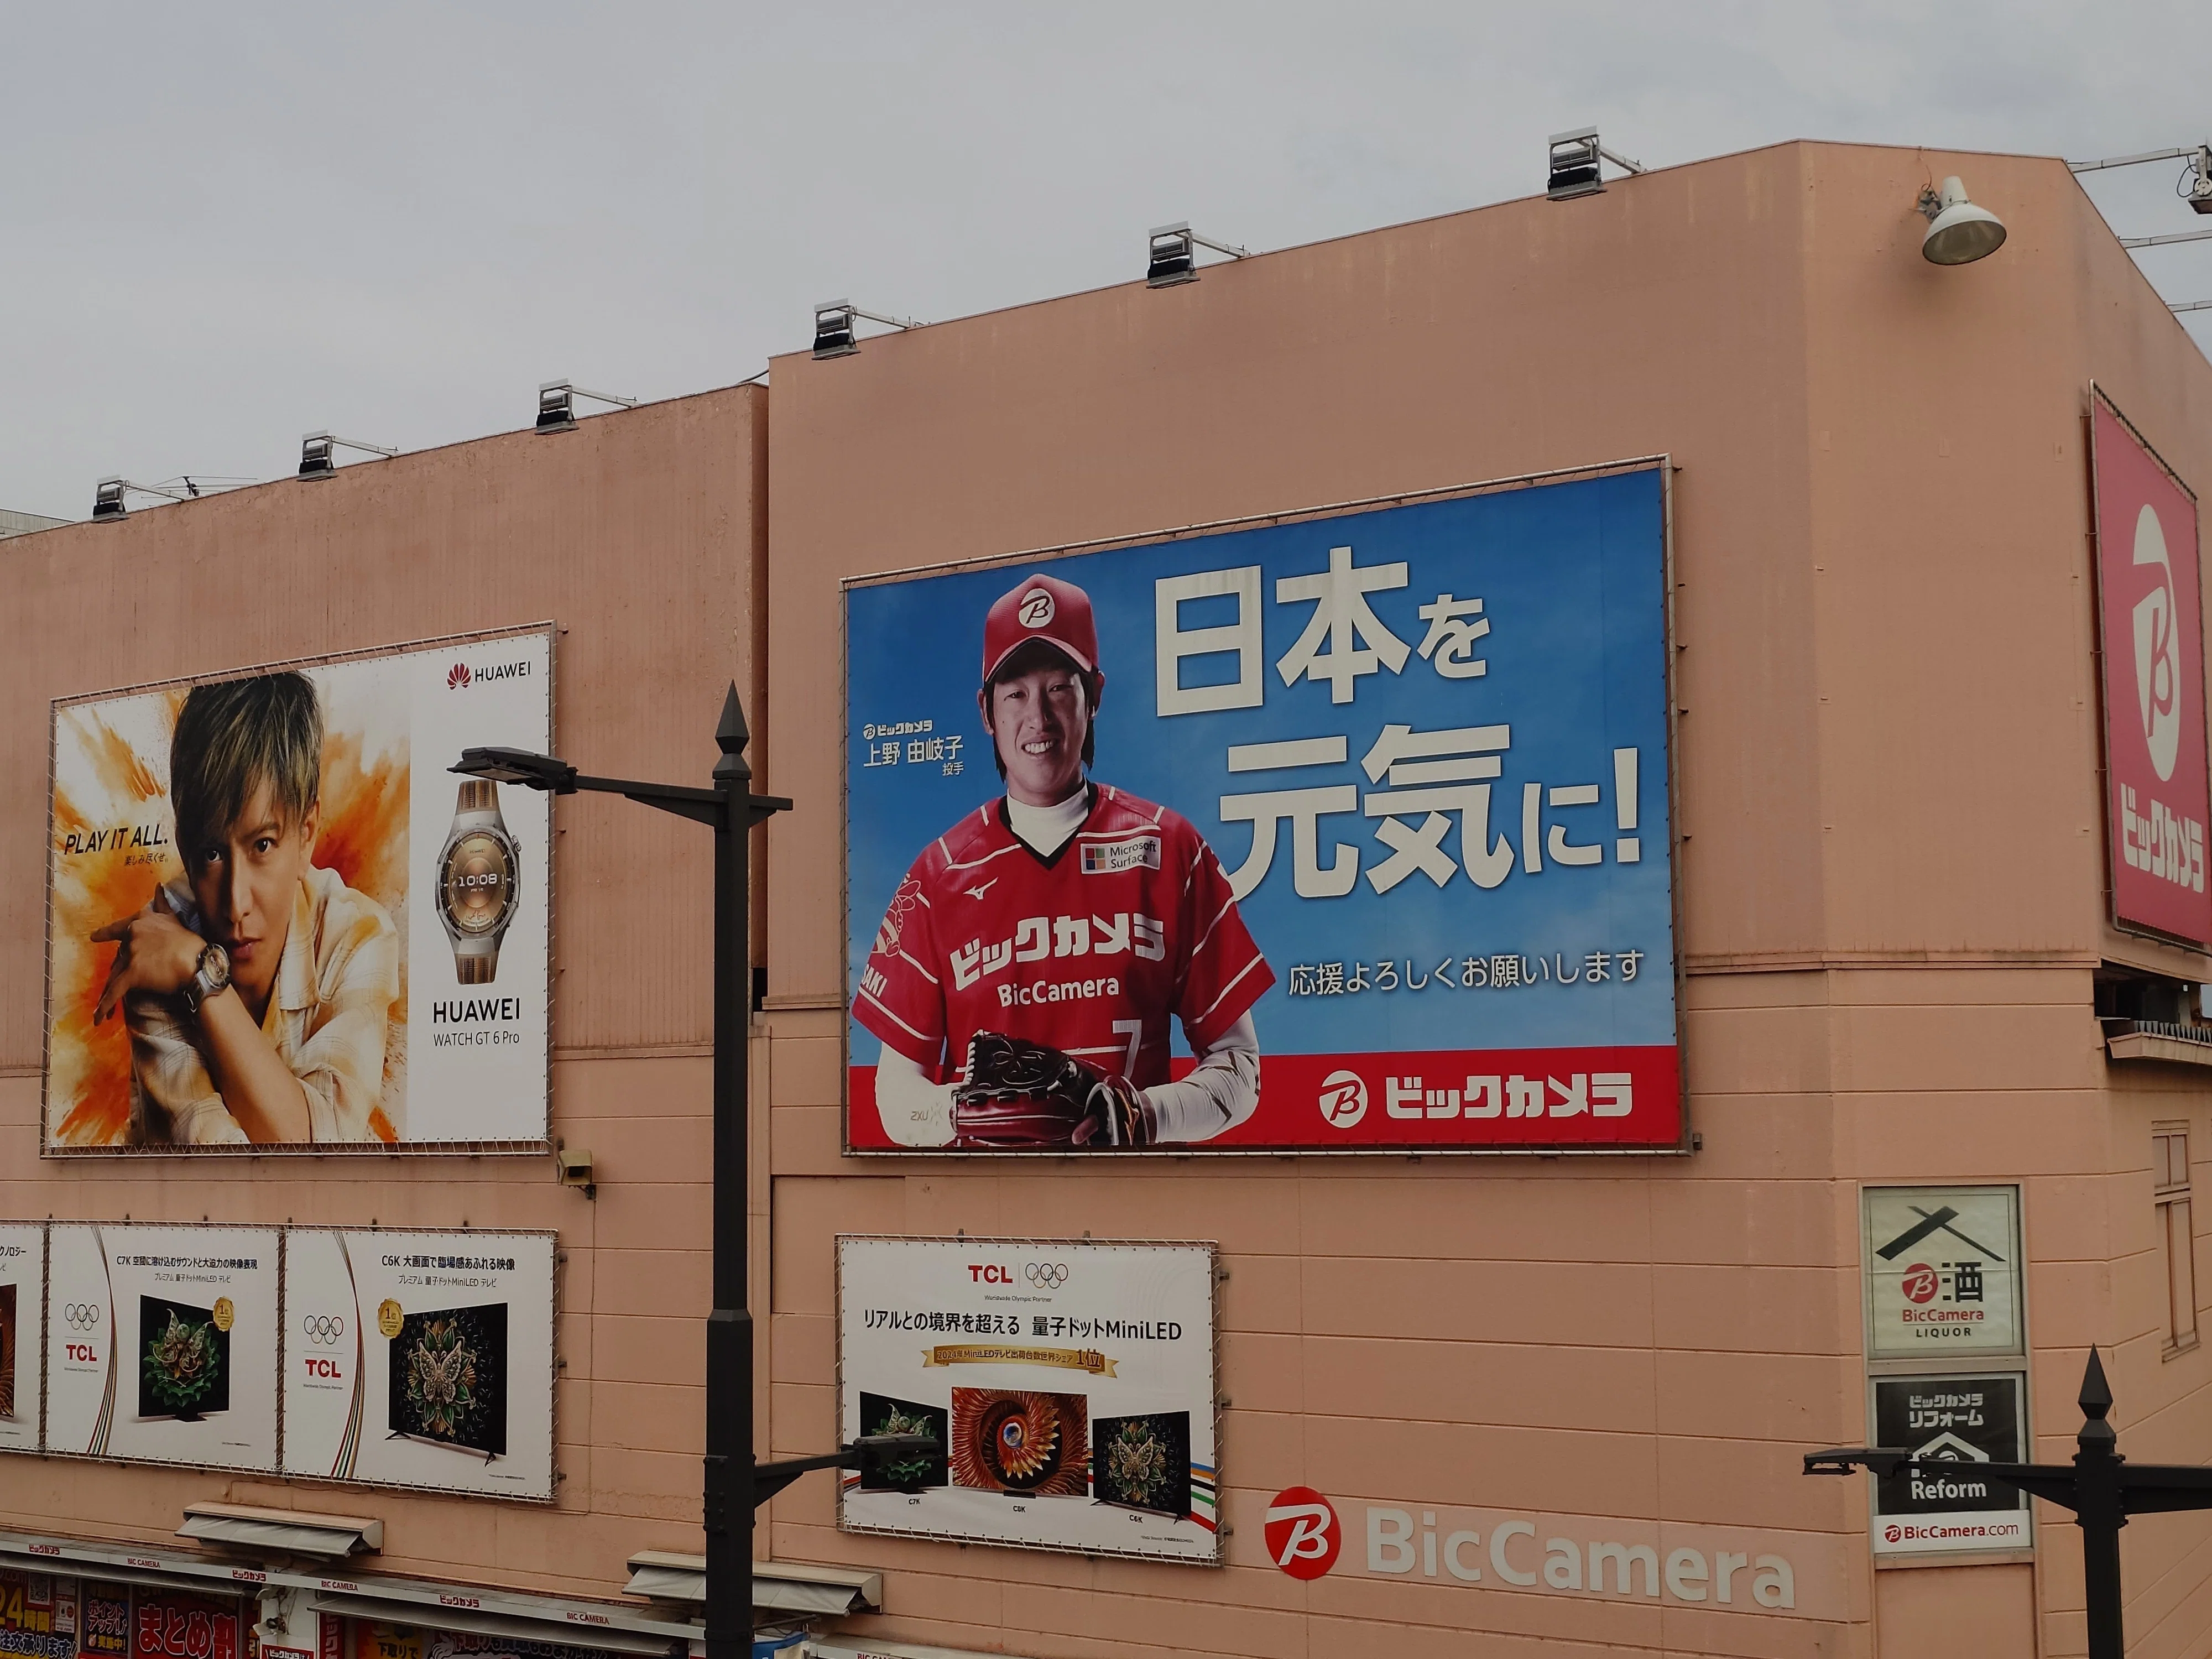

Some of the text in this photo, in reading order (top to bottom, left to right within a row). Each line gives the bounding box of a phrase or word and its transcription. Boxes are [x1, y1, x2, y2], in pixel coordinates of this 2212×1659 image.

[1155, 545, 1490, 716] 日本を
[475, 661, 530, 682] HUAWEI
[878, 719, 933, 736] ビックカメラ
[863, 735, 963, 767] 上野 由岐子
[942, 761, 964, 776] 投手
[64, 823, 168, 855] PLAY IT ALL.
[2120, 782, 2204, 893] ビックカメラ
[1110, 840, 1156, 856] Microsoft
[1111, 854, 1147, 868] Surface
[458, 874, 497, 887] 10:08
[950, 913, 1166, 992] ビックカメラ
[1289, 949, 1644, 996] 応援よろしくお願いします
[997, 977, 1119, 1007] BicCamera
[434, 998, 519, 1023] HUAWEI
[434, 1031, 519, 1046] WATCH GT 6 Pro
[1113, 1020, 1142, 1076] 7
[1386, 1073, 1632, 1119] ビックカメラ
[117, 1256, 131, 1265] C7K
[382, 1255, 515, 1271] C6K 大画面で臨場感あふれる映像
[398, 1275, 422, 1284] プレミアム
[481, 1279, 497, 1288] テレビ
[968, 1265, 1013, 1284] TCL
[864, 1309, 1181, 1340] リアルとの境界を超える 量子ドットMiniLED
[1903, 1310, 1984, 1322] BicCamera
[1917, 1327, 1971, 1338] LIQUOR
[66, 1344, 97, 1361] TCL
[305, 1359, 341, 1378] TCL
[1910, 1393, 1984, 1408] ビックカメラ
[1910, 1408, 1984, 1428] リフォーム
[1911, 1479, 1987, 1500] Reform
[1905, 1524, 2018, 1540] BicCamera.com
[1366, 1506, 1796, 1610] BicCamera
[332, 1582, 358, 1591] CAMERA
[88, 1599, 125, 1618] ポイント
[440, 1595, 479, 1608] ビックカメラ
[567, 1611, 609, 1625] BIC CAMERA
